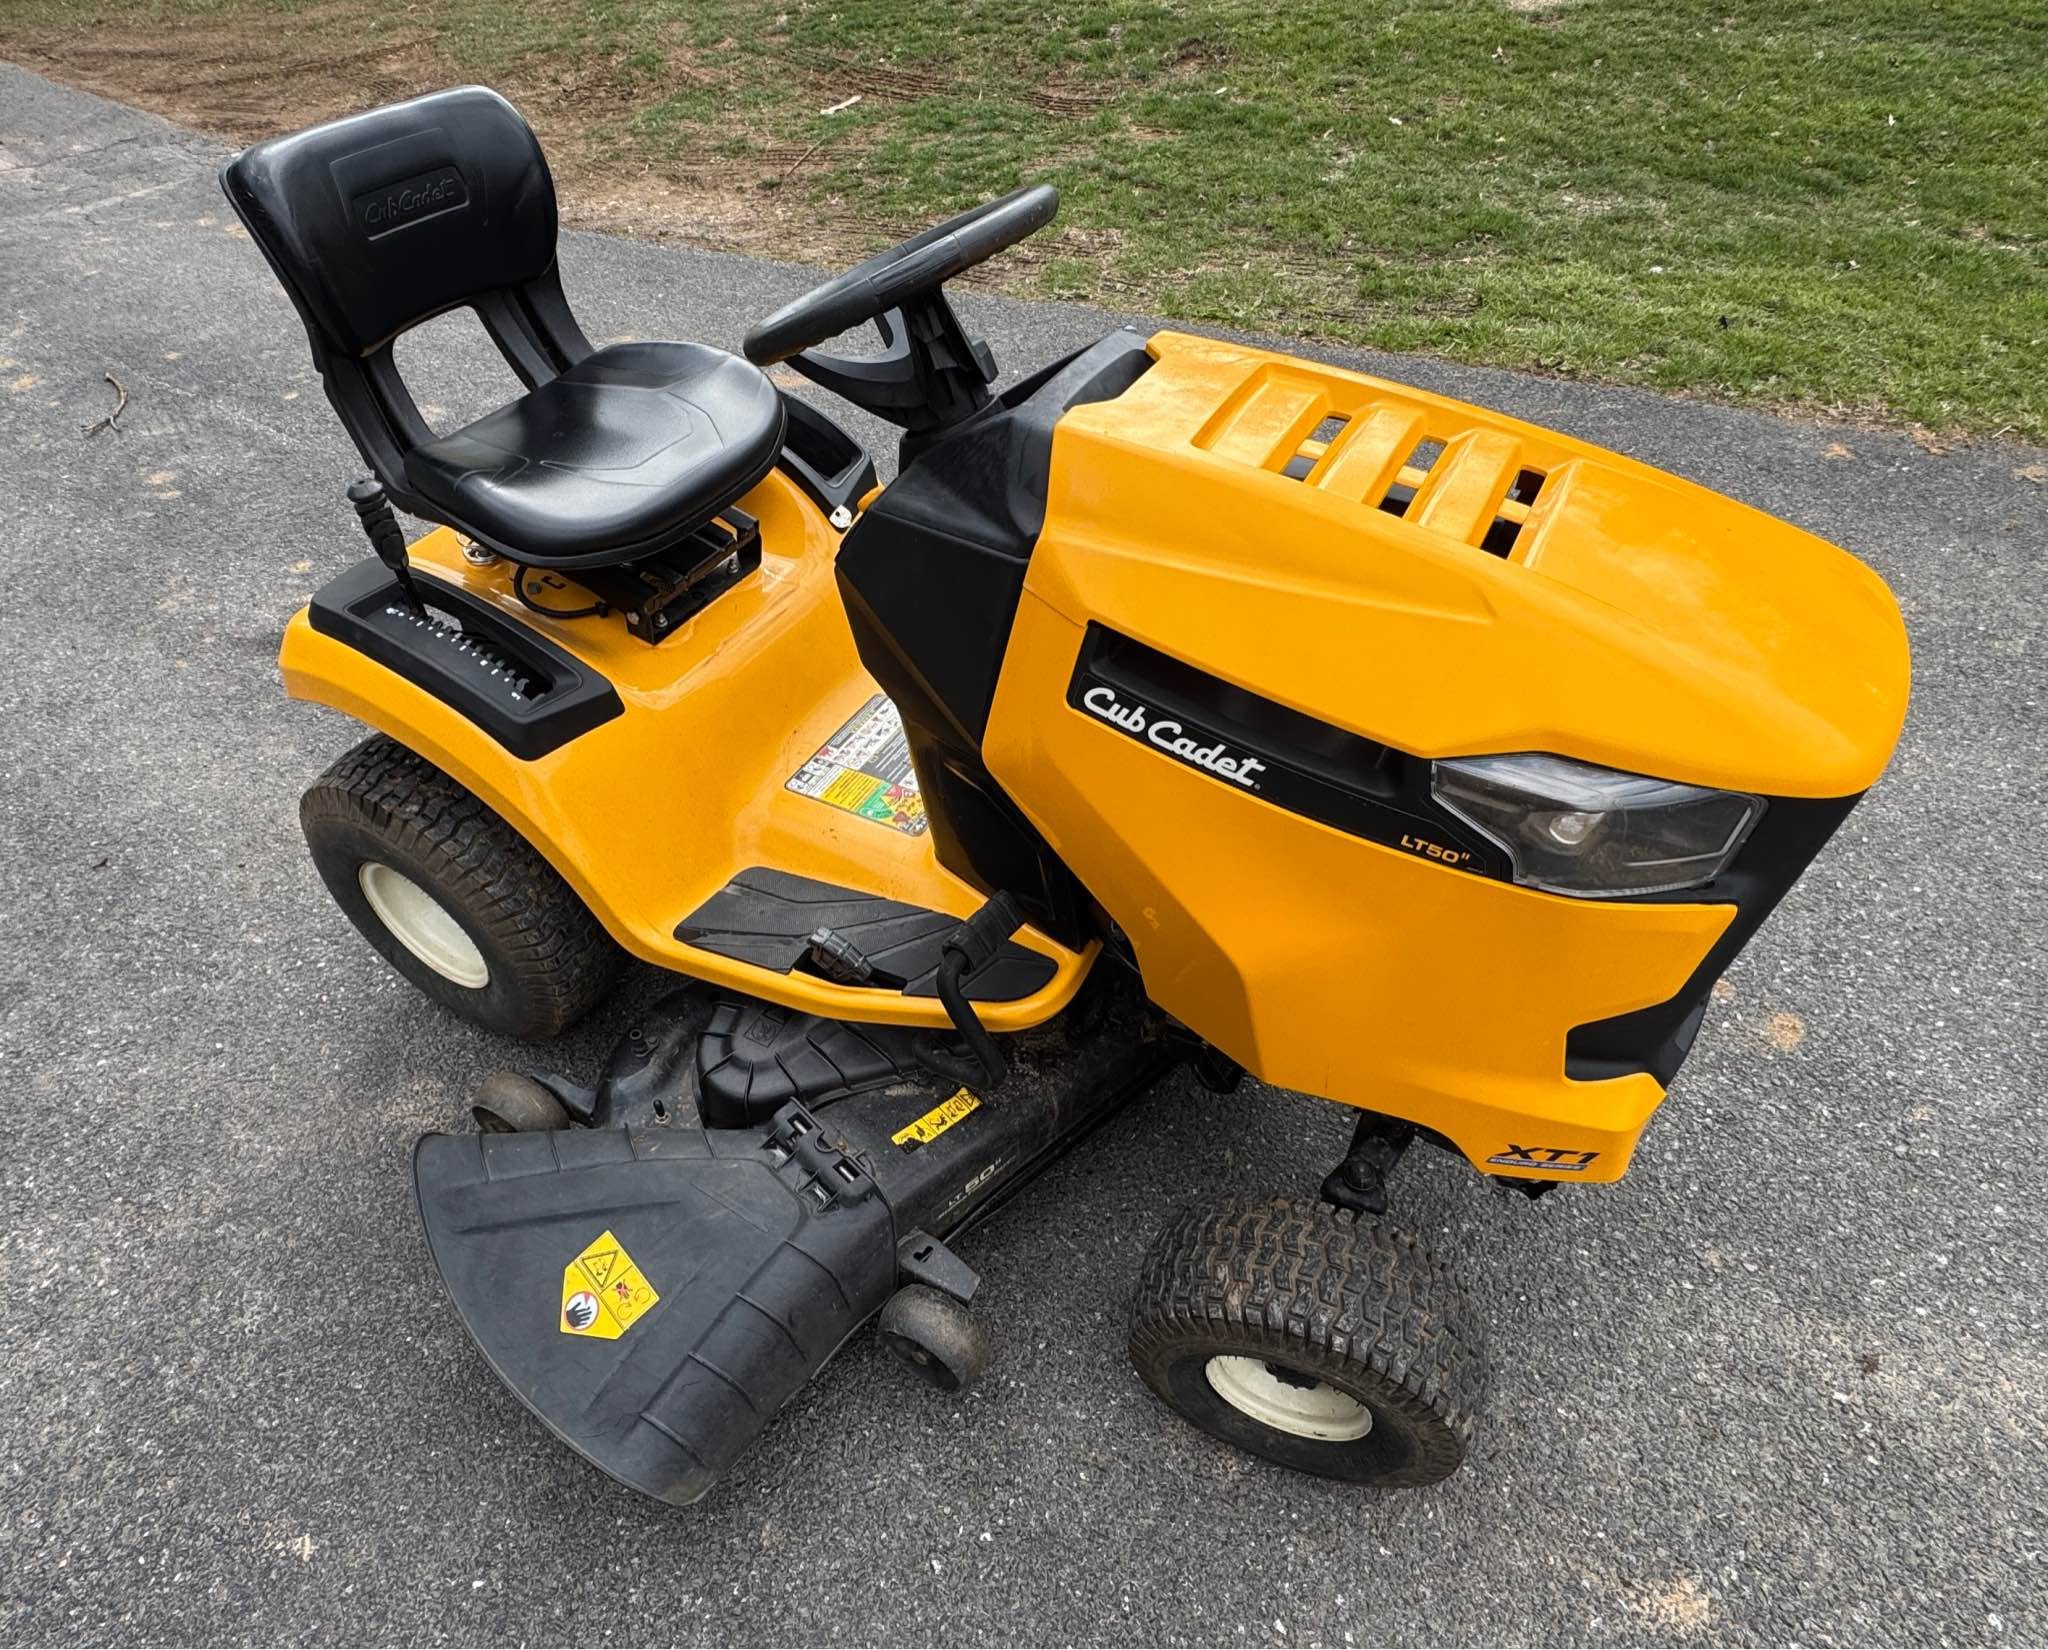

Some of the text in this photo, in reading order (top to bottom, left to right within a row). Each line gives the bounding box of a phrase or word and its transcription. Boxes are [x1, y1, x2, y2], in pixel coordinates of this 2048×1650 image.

[1083, 687, 1267, 787] Cub Cadet
[1400, 834, 1471, 864] LT50"
[1494, 1143, 1601, 1164] XT1
